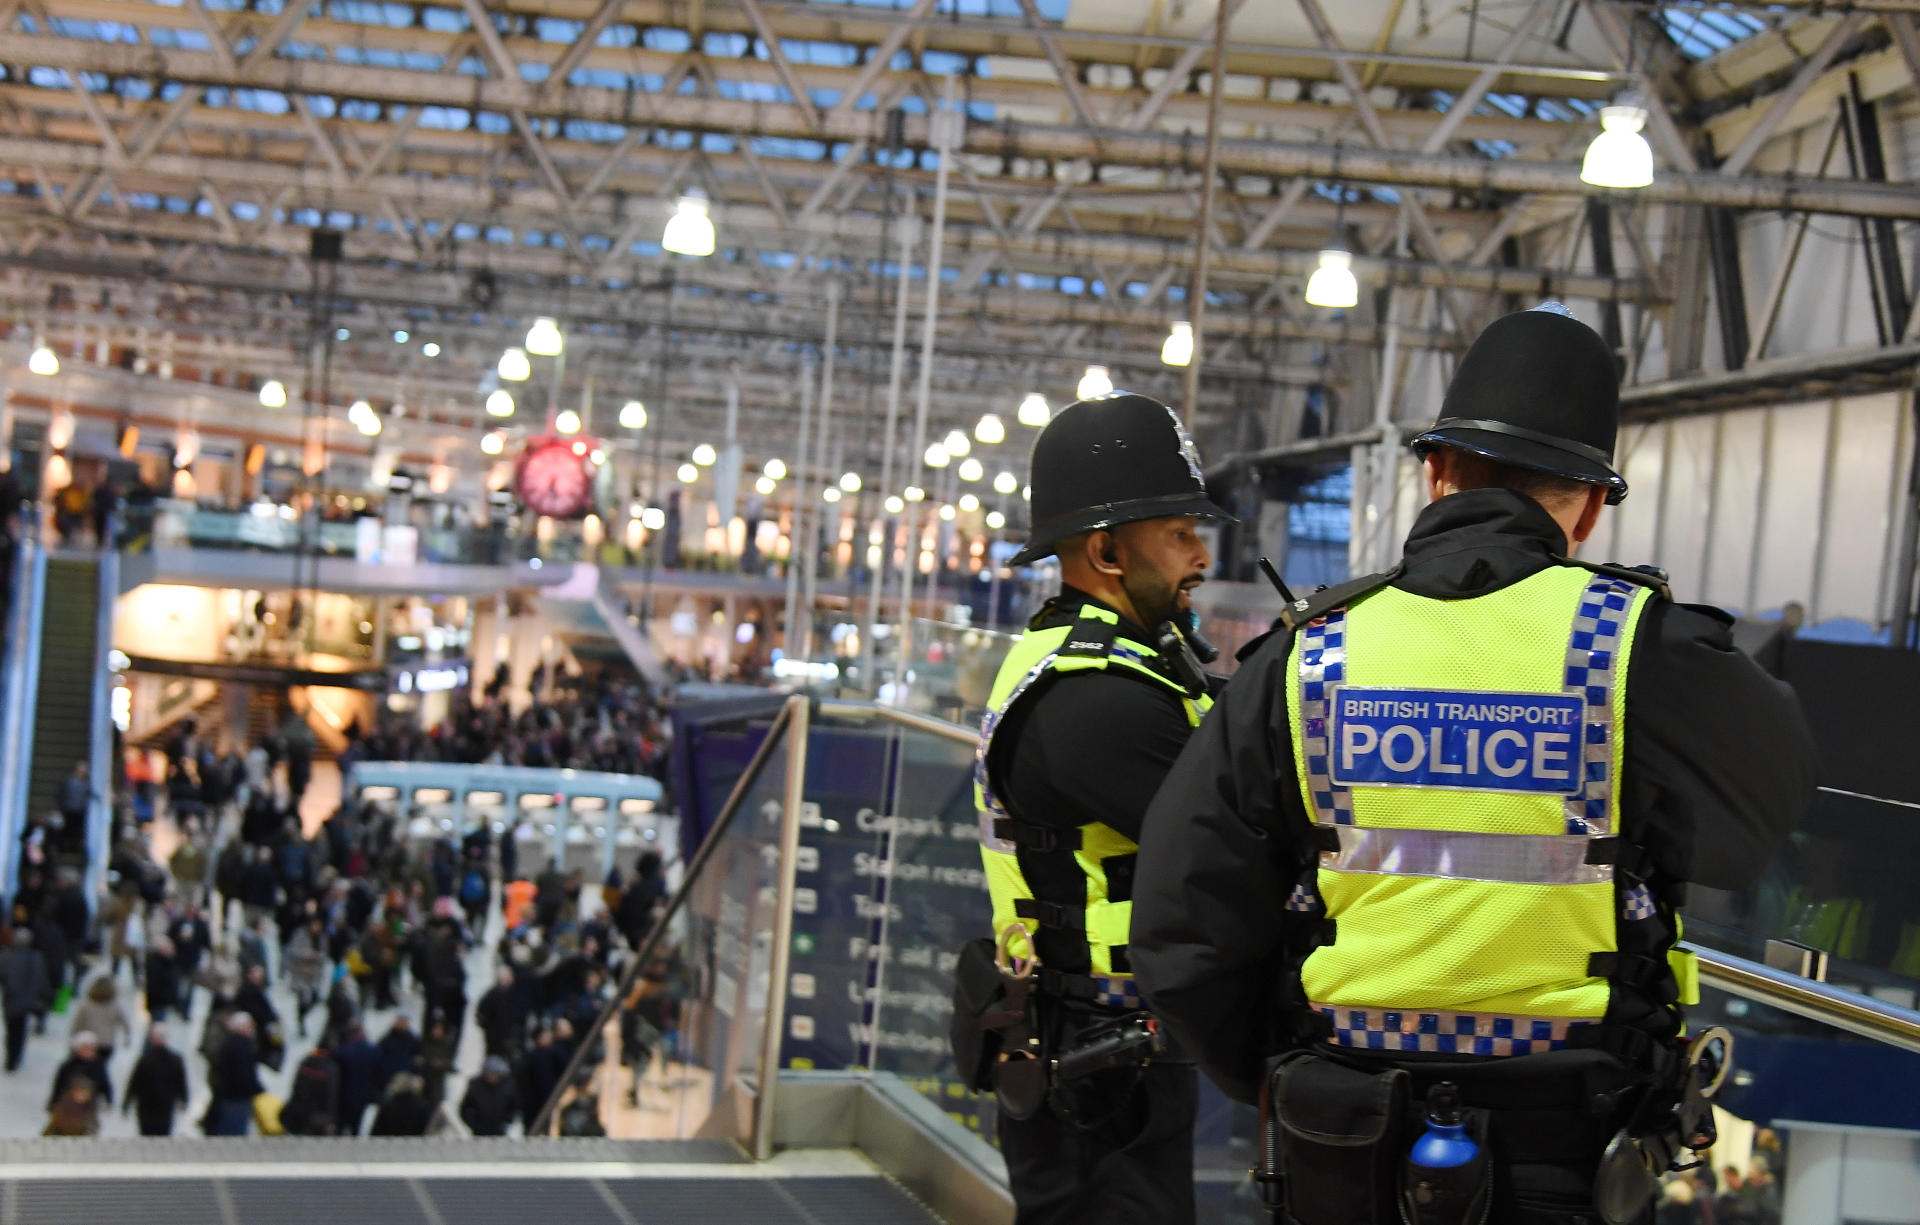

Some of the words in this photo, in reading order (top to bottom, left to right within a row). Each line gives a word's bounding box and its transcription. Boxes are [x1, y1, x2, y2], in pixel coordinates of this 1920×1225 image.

[1343, 699, 1430, 720] BRITISH
[1435, 702, 1573, 726] TRANSPORT
[1341, 722, 1571, 780] POLICE
